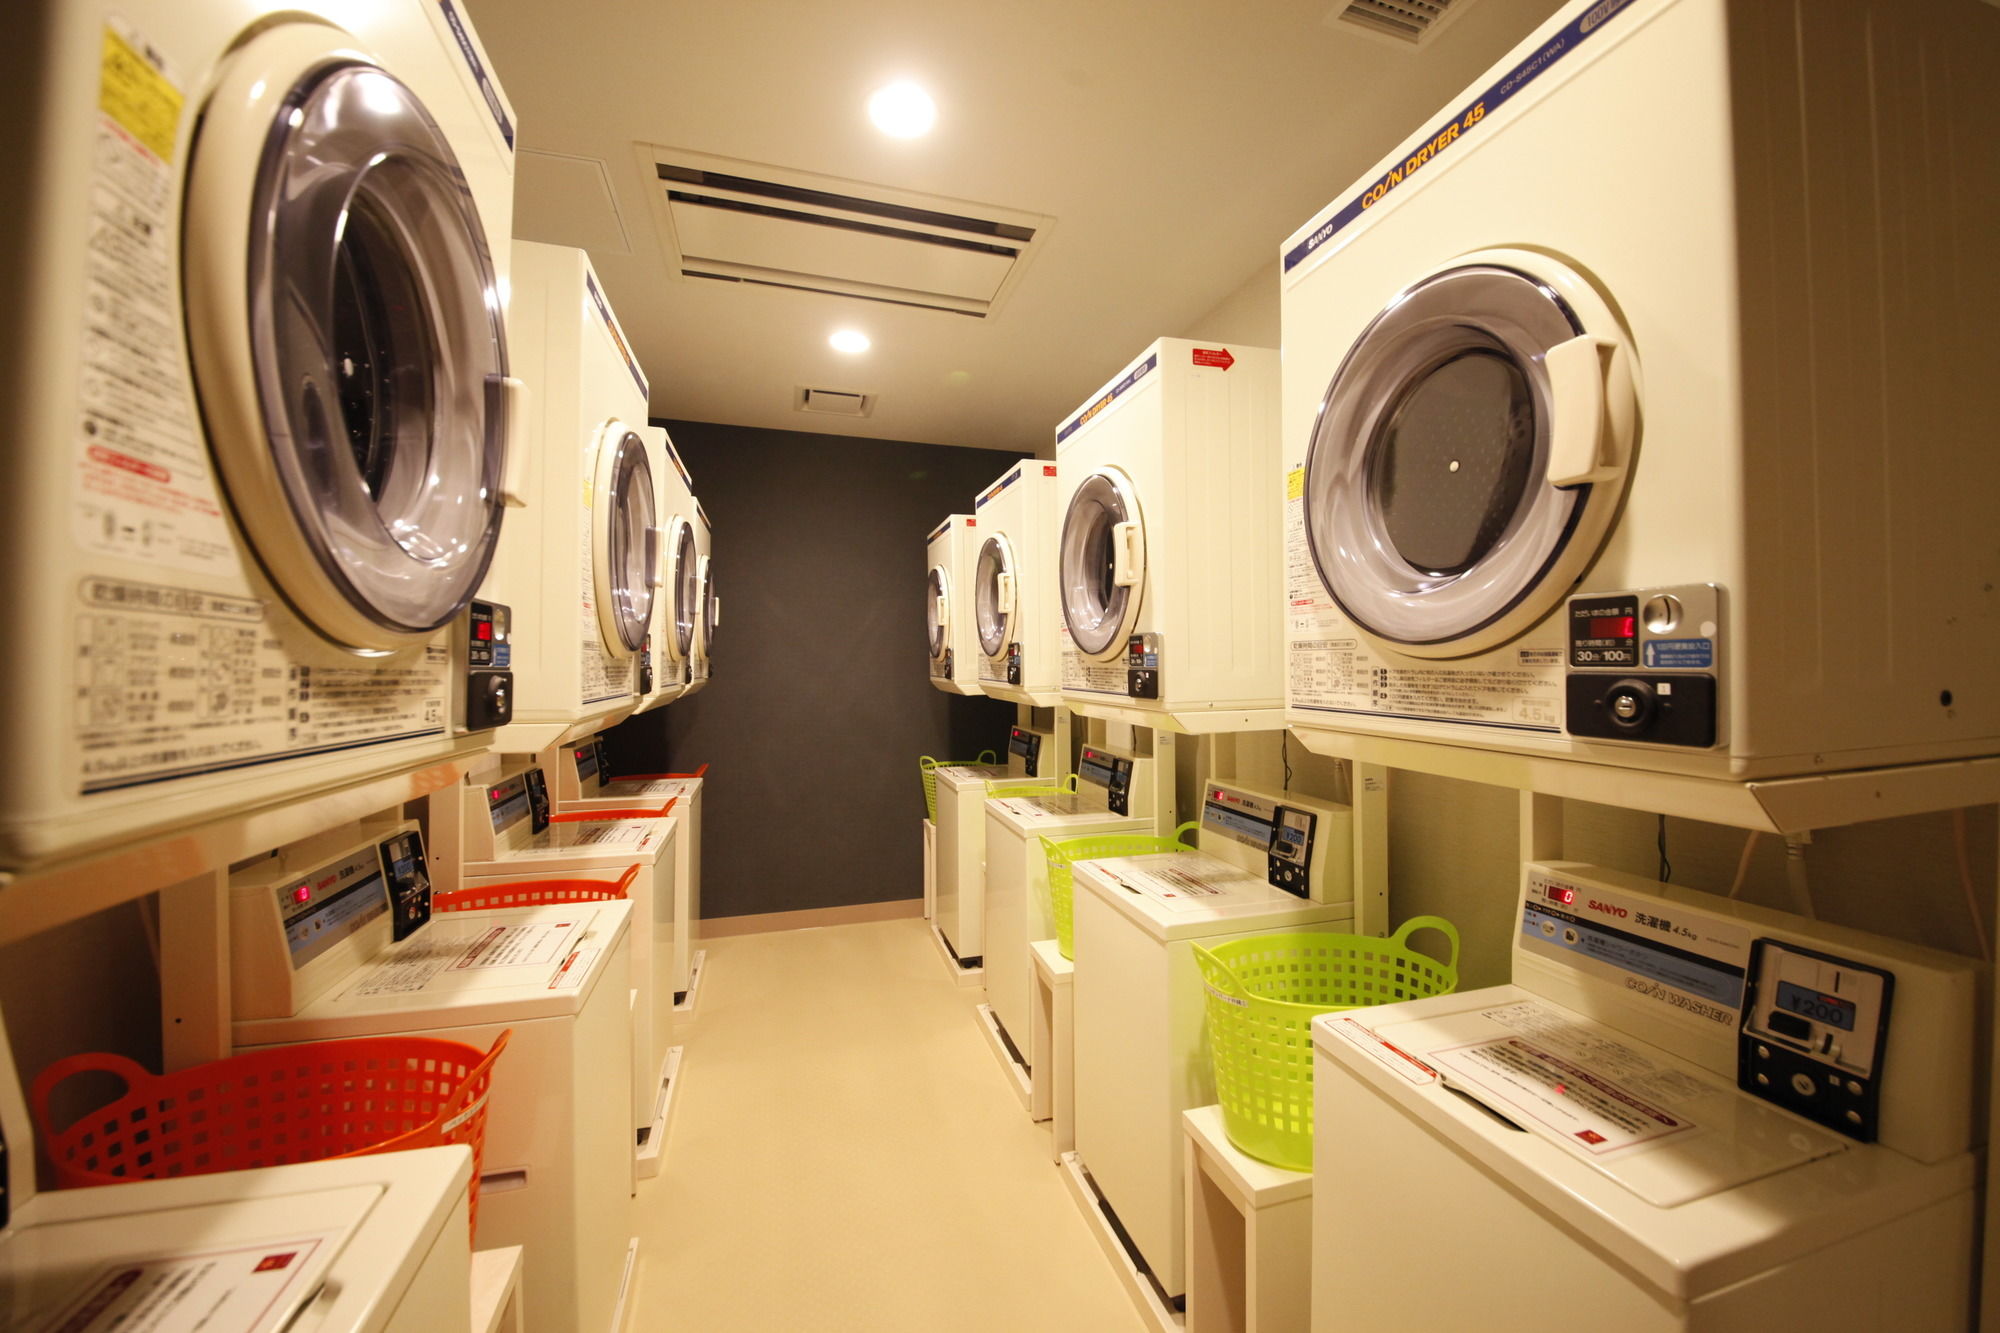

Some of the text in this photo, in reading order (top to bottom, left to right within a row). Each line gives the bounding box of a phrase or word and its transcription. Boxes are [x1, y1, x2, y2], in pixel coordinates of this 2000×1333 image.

[1361, 101, 1486, 210] COIN DRYER 45
[1307, 223, 1333, 250] SANYO
[1564, 891, 1573, 902] 0
[1587, 899, 1628, 919] SANYO
[1634, 912, 1698, 941] 洗濯機 4.5kg
[1625, 976, 1733, 1027] COIN WASHER
[1791, 994, 1844, 1025] ¥200
